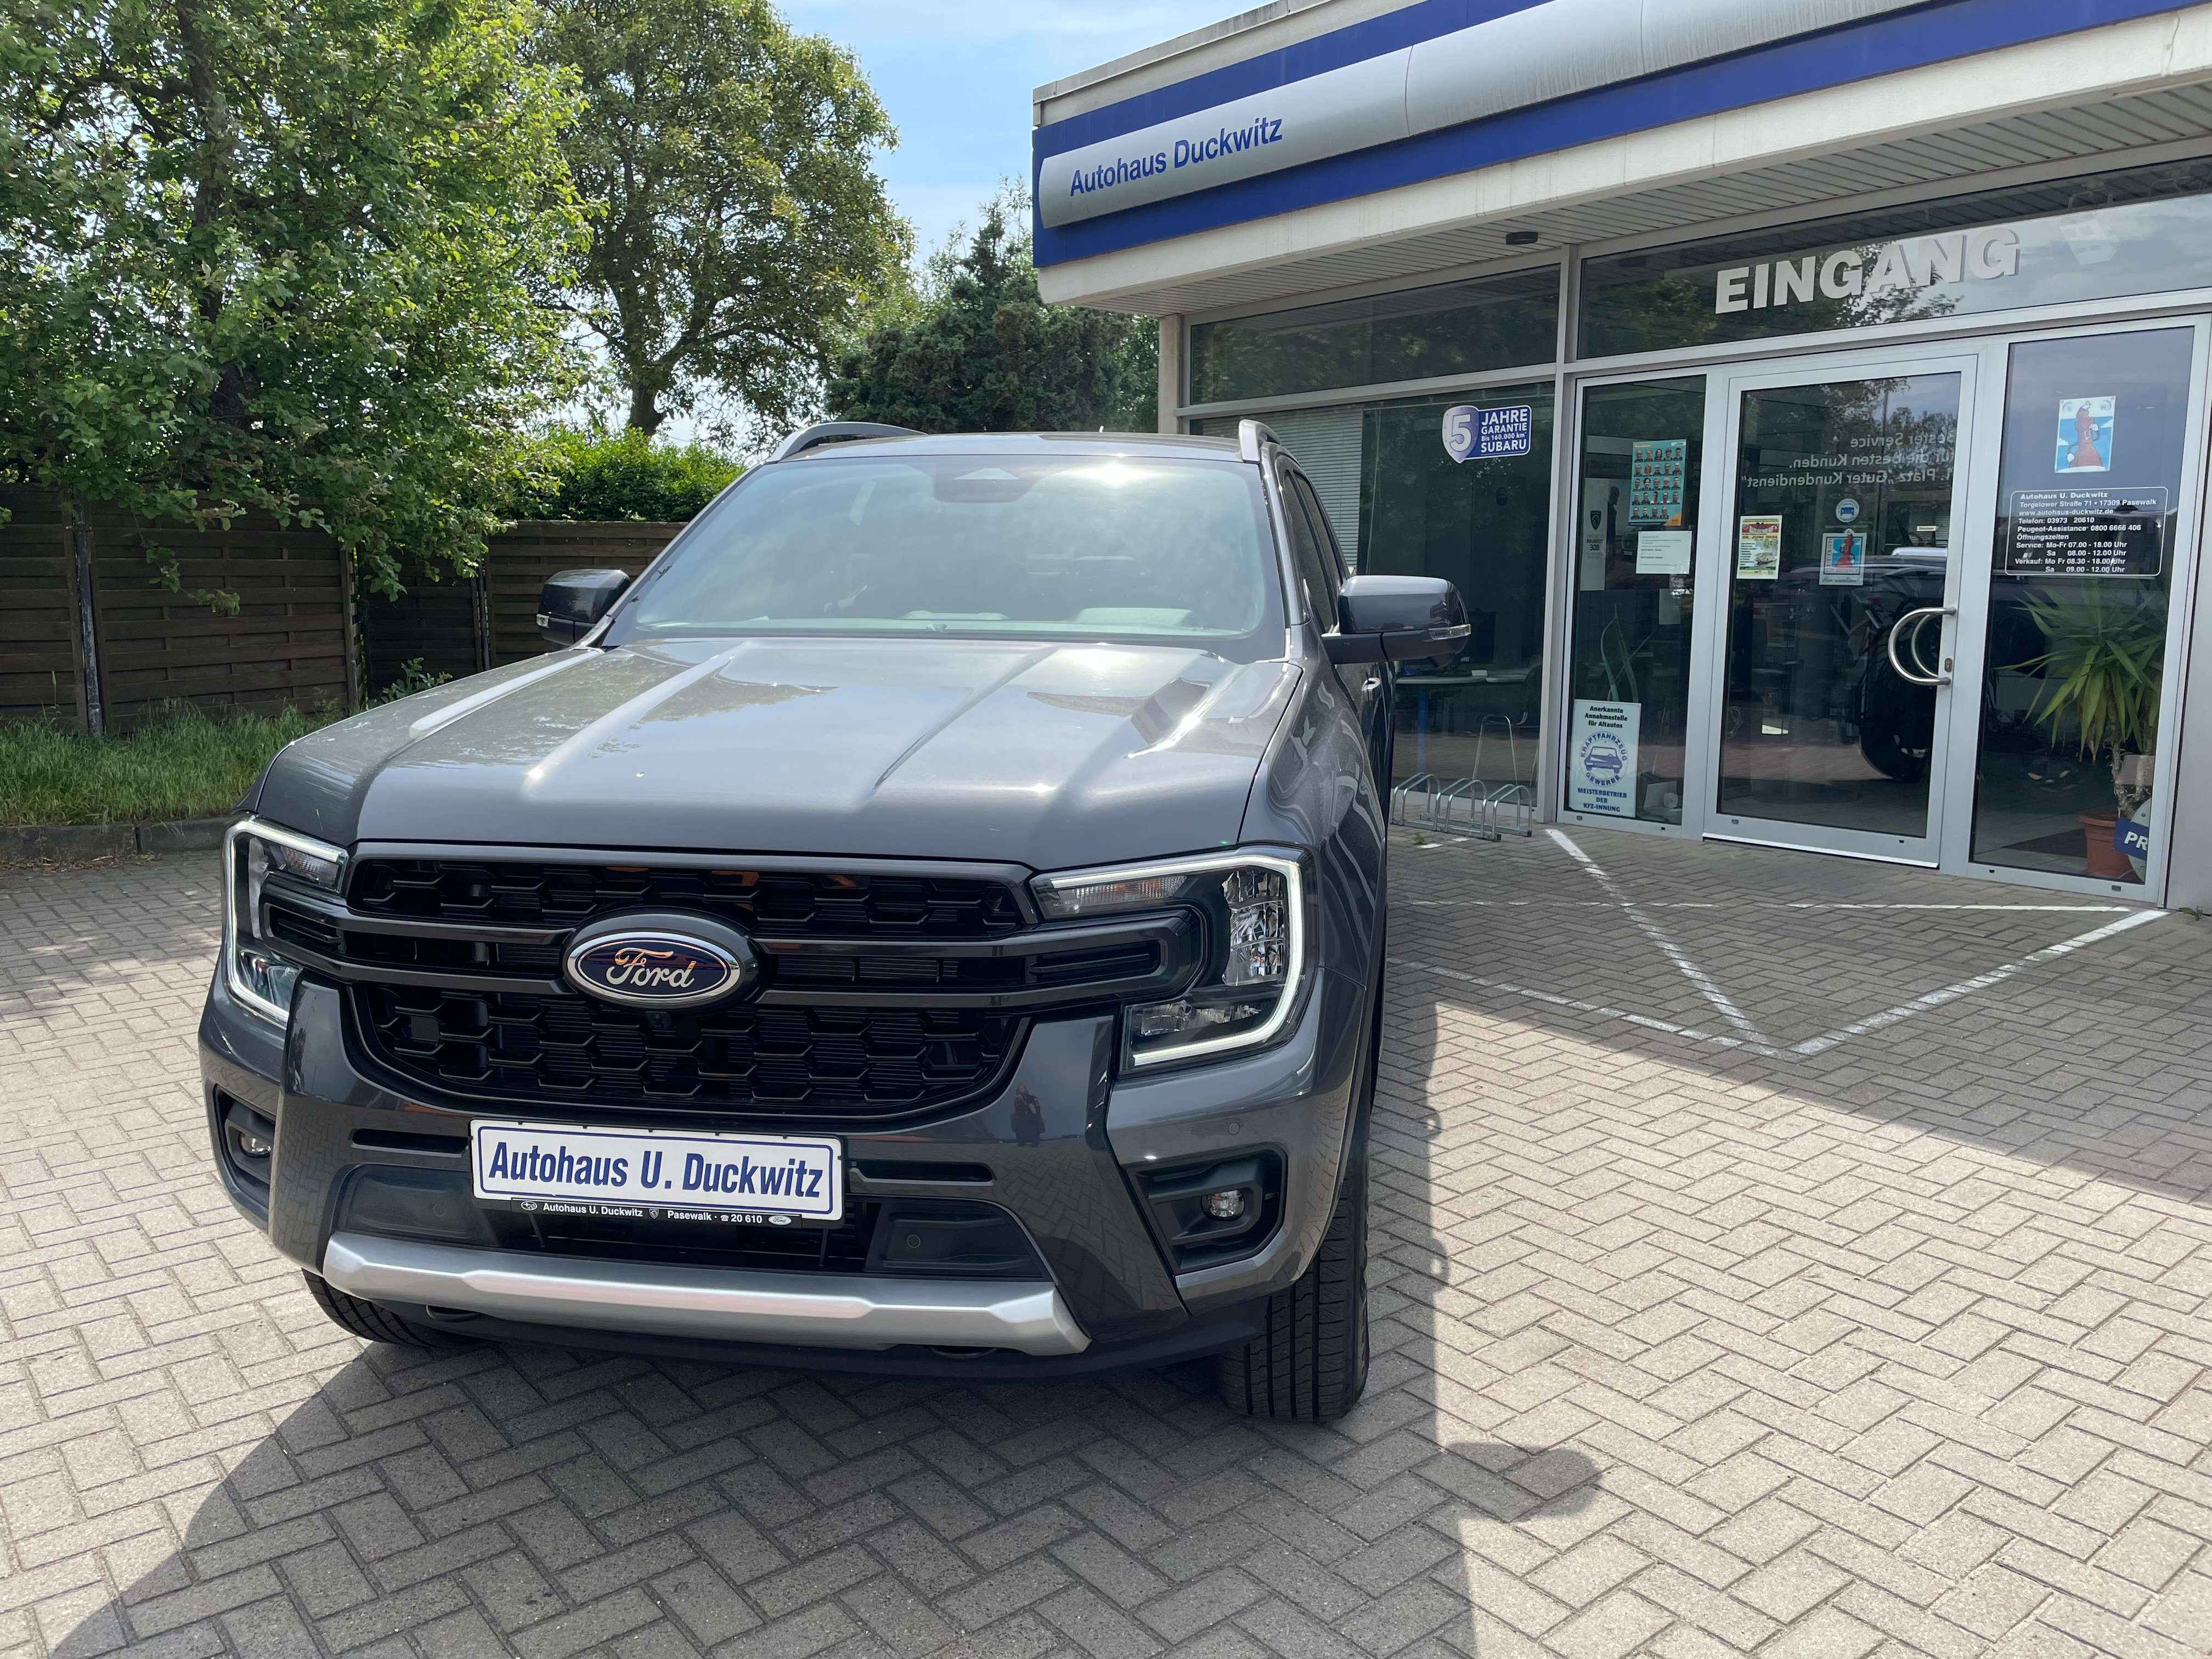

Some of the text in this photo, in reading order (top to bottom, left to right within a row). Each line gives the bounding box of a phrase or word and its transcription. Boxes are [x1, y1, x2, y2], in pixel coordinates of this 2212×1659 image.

[1070, 117, 1283, 198] Autohaus Duckwitz
[1715, 227, 2021, 315] EINGANG
[1481, 408, 1528, 426] JAHRE
[1449, 414, 1472, 452] 5
[1481, 422, 1527, 435] GARANTIE
[1491, 432, 1515, 441] 160.000
[1480, 438, 1527, 453] SUBARU
[2019, 508, 2114, 516] www.autohaus-duckwitz.de
[2017, 533, 2069, 541] Öffnungszeiten
[1584, 713, 1628, 721] Annahmestelle
[1589, 706, 1624, 714] Anerkannte
[1581, 732, 1627, 761] KRAFTFAHRZEUG
[1585, 771, 1621, 786] GEWERBE
[1577, 787, 1628, 798] MEISTERBETRIEB
[1583, 803, 1621, 812] KFZ-INNUNG
[606, 947, 697, 988] Ford
[488, 1141, 824, 1199] Autohaus U. Duckwitz
[543, 1203, 763, 1224] Autohaus U. Duckwitz Pasewalk 20 610
